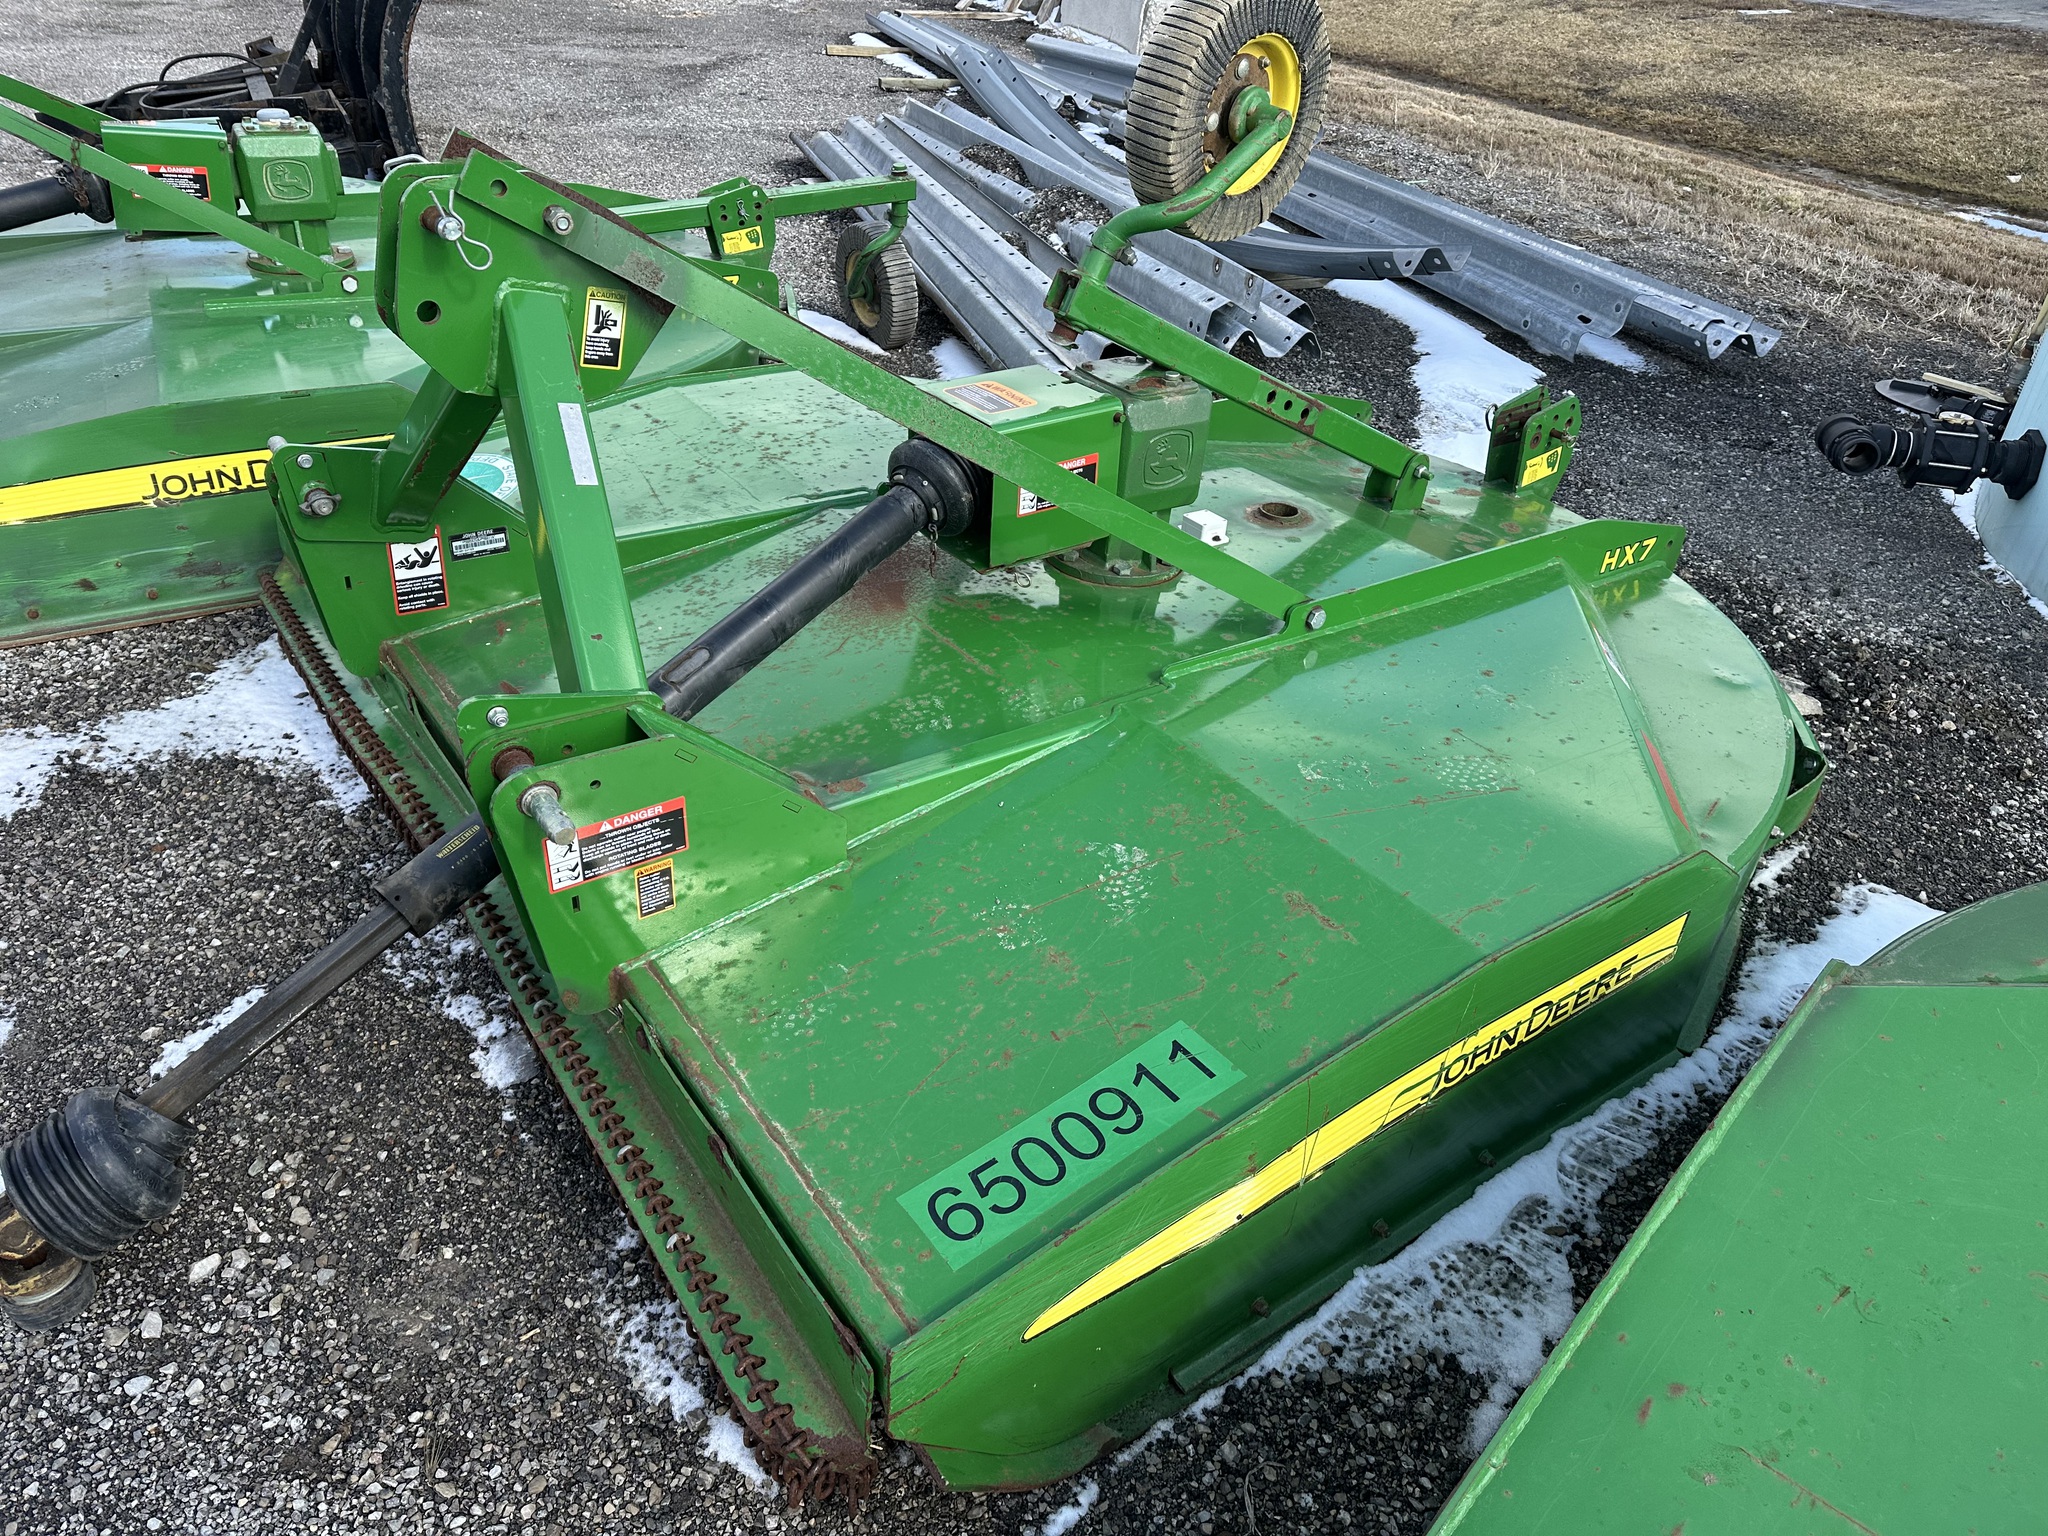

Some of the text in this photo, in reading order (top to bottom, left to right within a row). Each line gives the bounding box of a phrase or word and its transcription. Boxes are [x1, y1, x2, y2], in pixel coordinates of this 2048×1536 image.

[596, 292, 626, 300] CAUTION
[1058, 458, 1086, 470] ANGER
[142, 466, 242, 500] JOHN
[1600, 536, 1658, 574] HX7
[604, 818, 660, 838] THROWN OBJECTS
[614, 805, 663, 828] DANGER
[436, 824, 480, 858] WALTERSCHEID
[608, 840, 662, 862] ROTATING BLADES
[644, 860, 672, 873] WARNING
[1421, 954, 1639, 1100] JOHN DEERE
[927, 1039, 1217, 1242] 6500911
